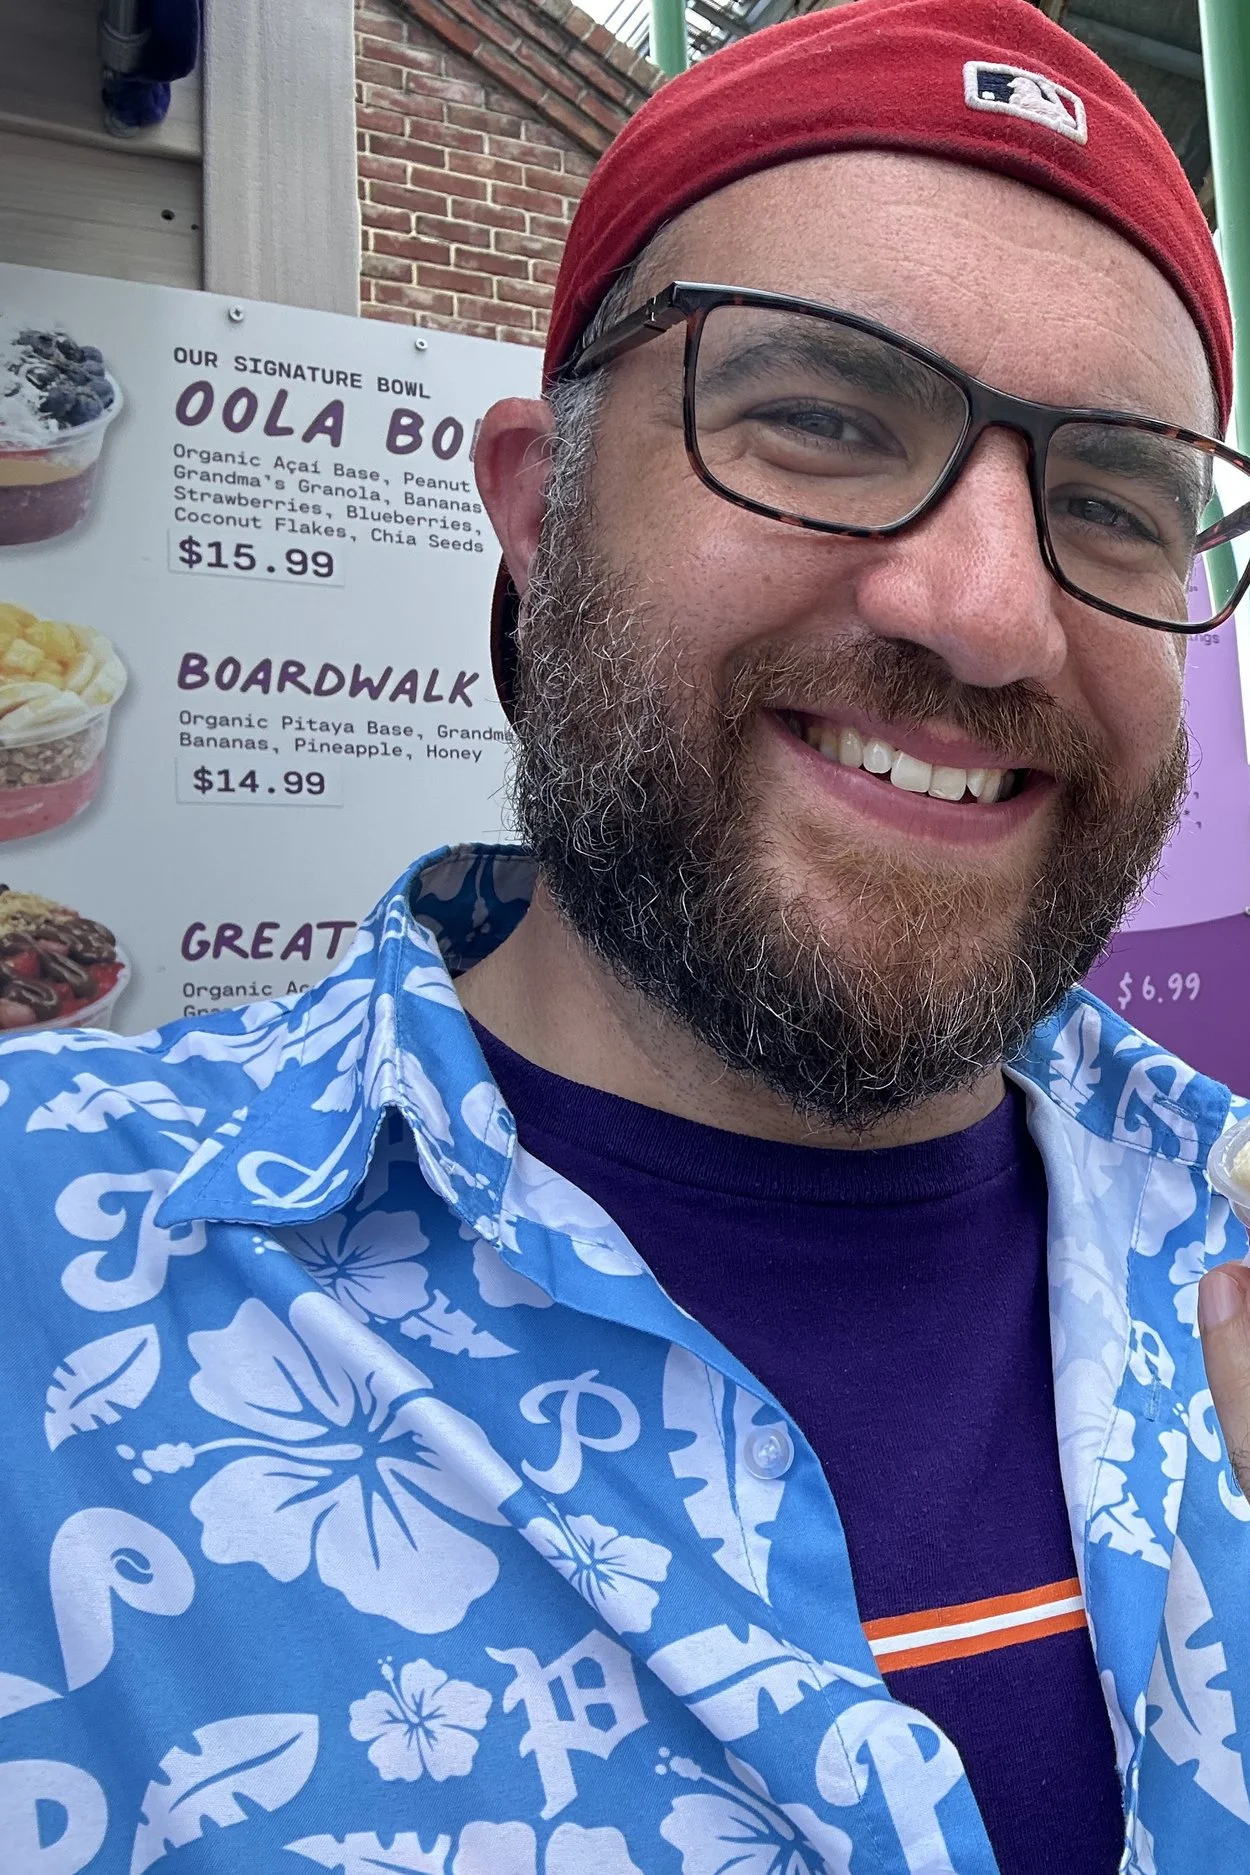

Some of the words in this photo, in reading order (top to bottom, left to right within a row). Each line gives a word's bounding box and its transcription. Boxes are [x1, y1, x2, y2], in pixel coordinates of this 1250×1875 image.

[173, 346, 218, 368] OUR
[233, 355, 362, 389] SIGNATURE
[377, 376, 431, 399] BOWL
[175, 379, 345, 448] OOLA
[385, 407, 482, 463] BO
[173, 443, 261, 467] Organic
[333, 462, 389, 486] Base,
[403, 471, 471, 493] Peanut
[173, 464, 285, 491] Grandma's
[298, 478, 390, 506] Granola,
[404, 491, 482, 514] Bananas
[173, 485, 332, 519] Strawberries,
[346, 504, 481, 536] Blueberries,
[174, 506, 262, 529] Coconut
[275, 516, 357, 542] Flakes,
[371, 527, 417, 546] Chia
[428, 534, 484, 553] Seeds
[178, 534, 334, 579] $15.99
[177, 651, 480, 708] BOARDWALK
[179, 709, 268, 730] Organic
[281, 714, 354, 736] Pitaya
[367, 720, 423, 740] Base,
[179, 731, 279, 755] Bananas,
[294, 737, 412, 761] Pineapple,
[426, 744, 483, 763] Honey
[193, 764, 325, 795] $14.99
[181, 920, 357, 961] GREAT
[182, 981, 273, 1001] Organic
[519, 1370, 641, 1494] P
